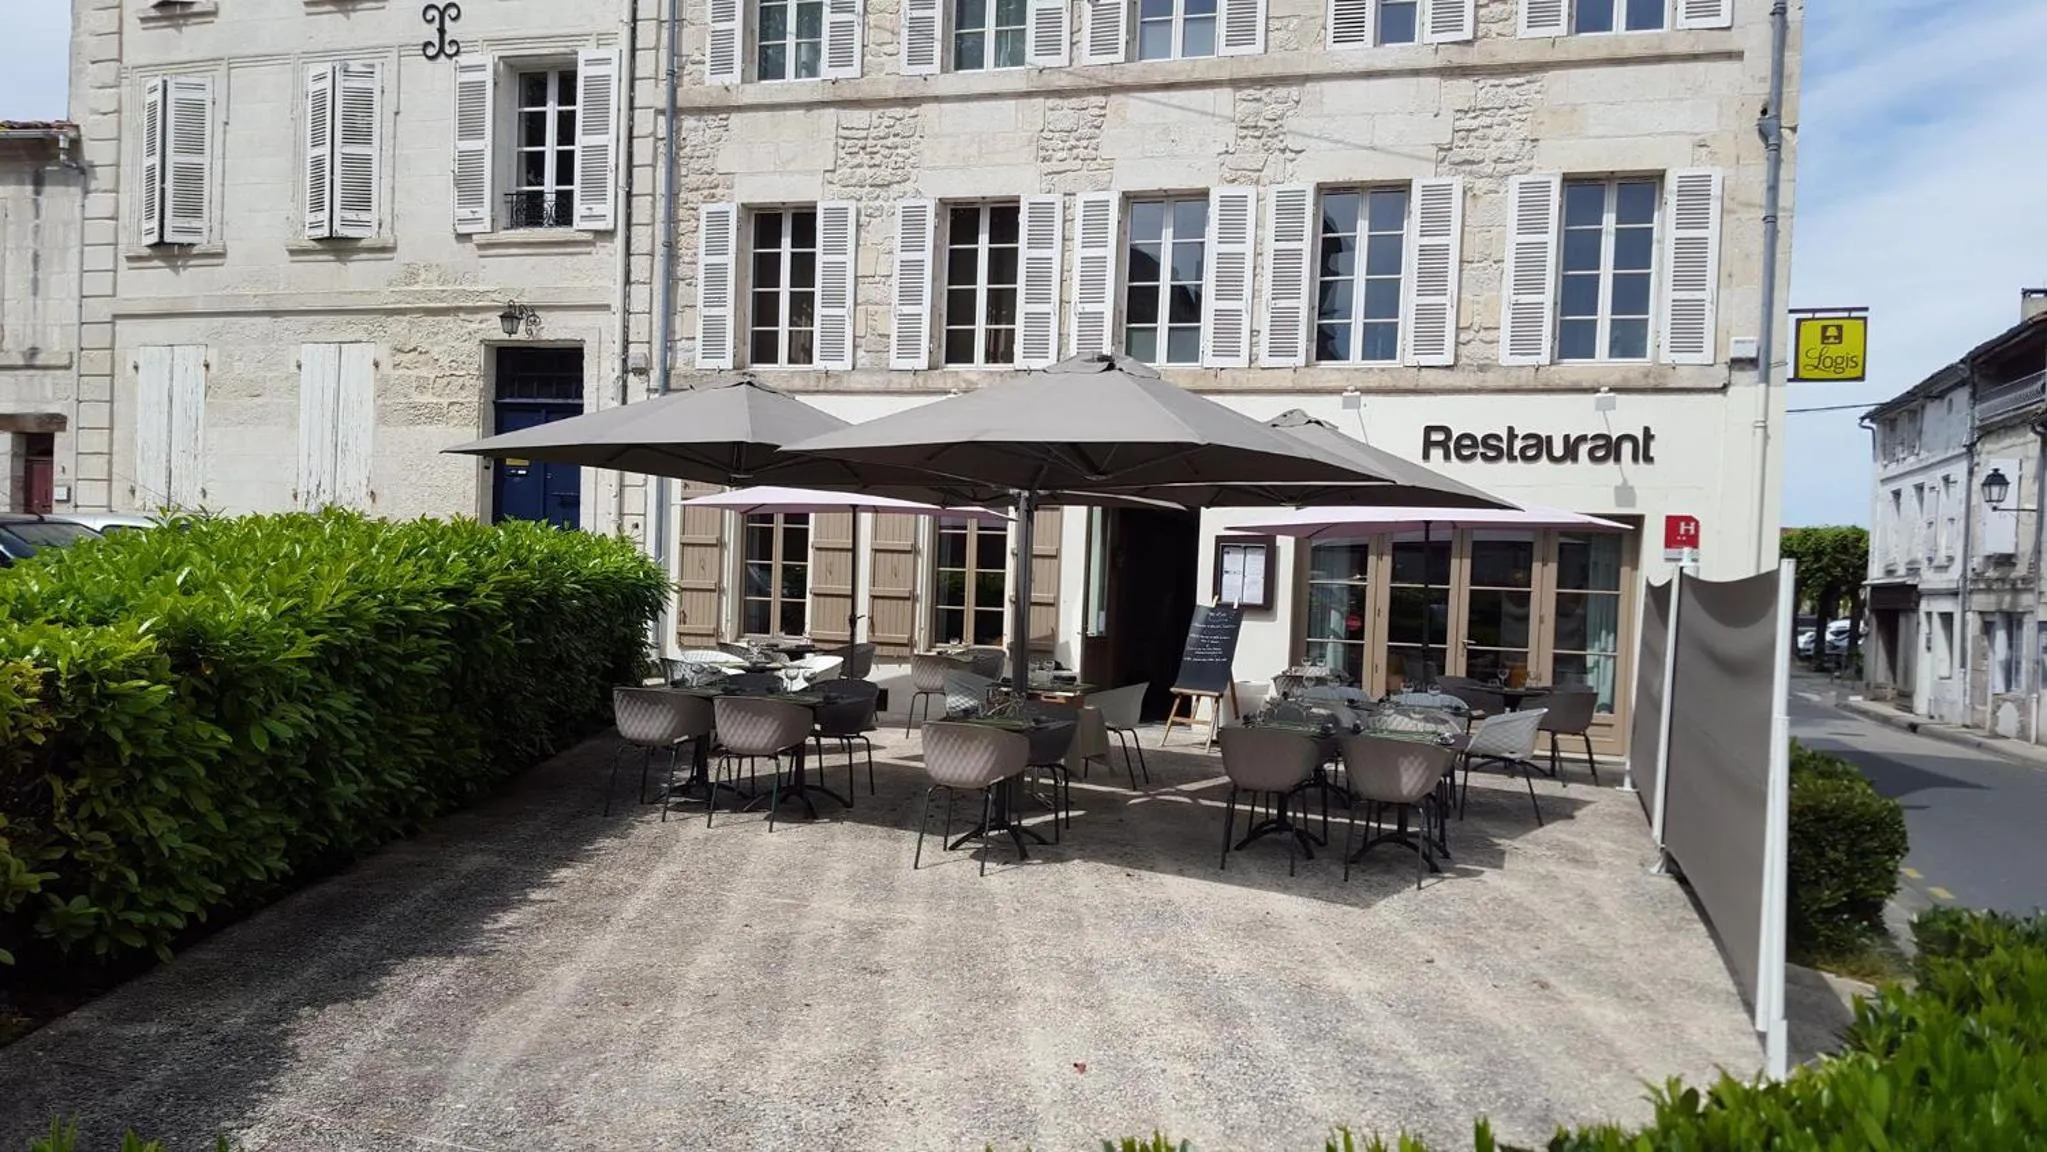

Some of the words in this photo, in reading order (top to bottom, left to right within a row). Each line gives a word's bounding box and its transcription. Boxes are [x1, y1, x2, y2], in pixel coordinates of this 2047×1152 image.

[1803, 346, 1859, 374] Logis
[1422, 425, 1655, 463] Restaurant
[1679, 521, 1696, 535] H
